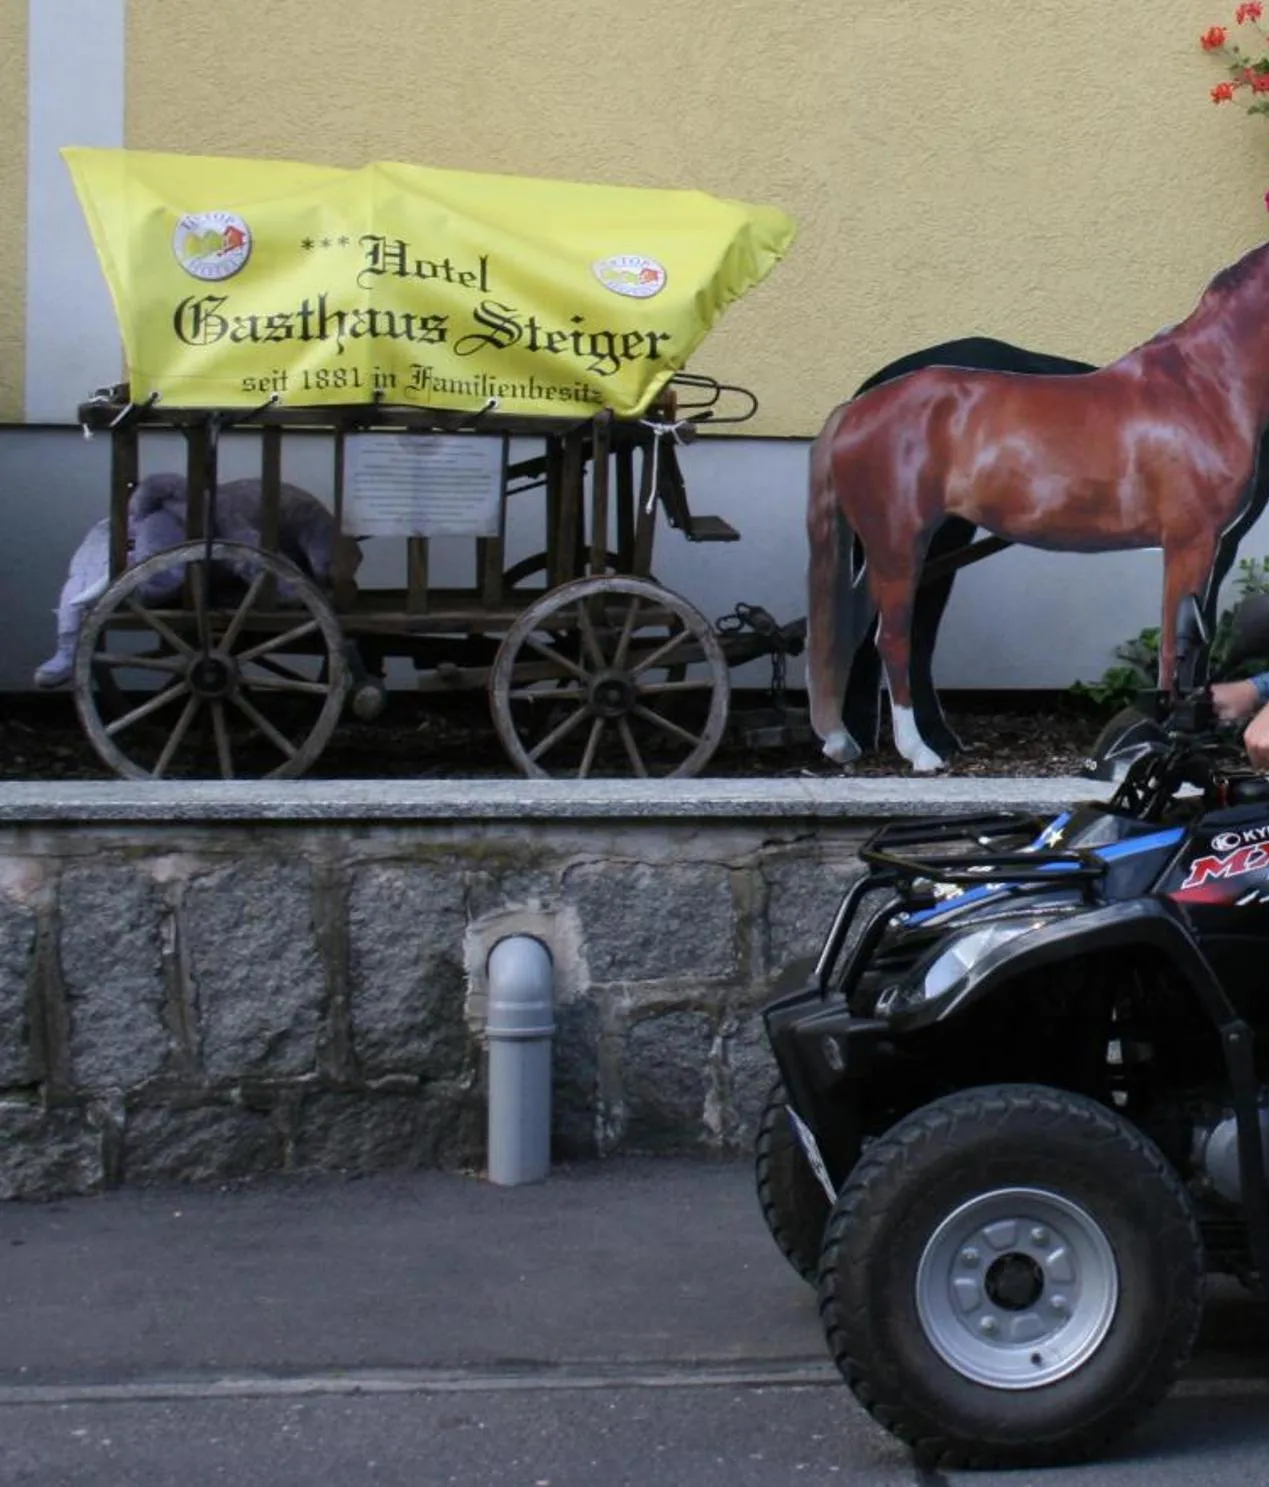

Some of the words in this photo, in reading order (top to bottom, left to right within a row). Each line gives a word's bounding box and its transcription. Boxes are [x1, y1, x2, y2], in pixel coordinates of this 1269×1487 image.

[356, 234, 491, 293] Hotel
[173, 291, 450, 355] Gasthaus
[452, 299, 671, 377] Steiger
[241, 367, 289, 392] seit
[302, 366, 363, 391] 1881
[373, 366, 398, 390] in
[405, 362, 604, 403] Familienbesitz
